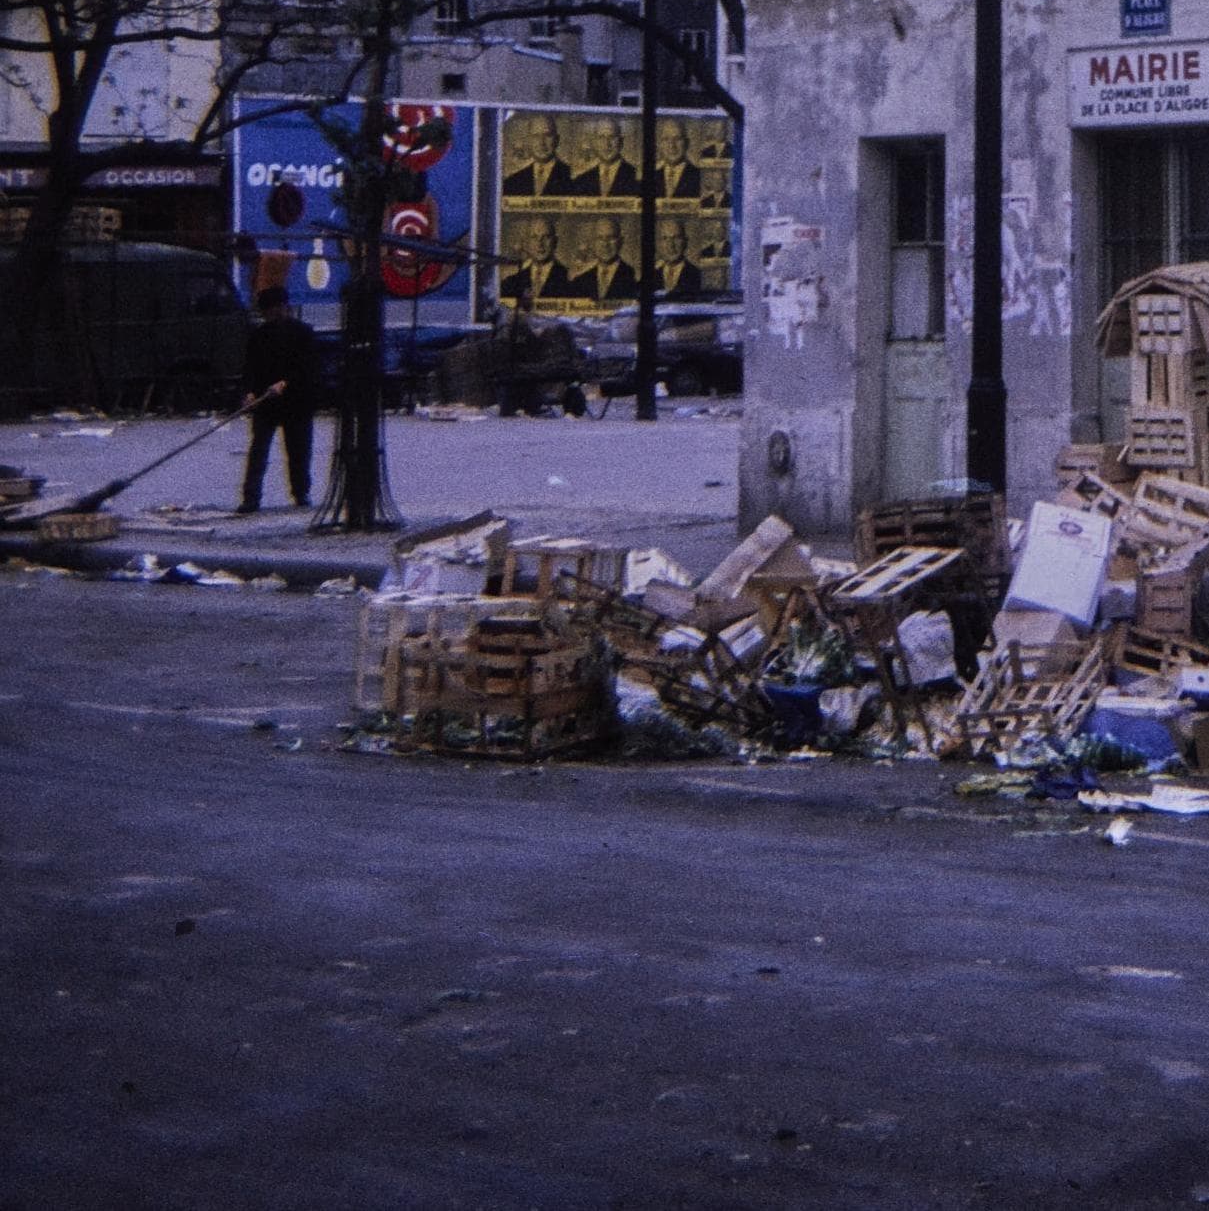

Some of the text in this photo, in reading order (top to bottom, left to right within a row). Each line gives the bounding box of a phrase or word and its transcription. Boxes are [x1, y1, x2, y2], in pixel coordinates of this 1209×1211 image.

[1088, 51, 1201, 86] MAIRIE
[1081, 98, 1209, 117] DE LA PLACE D'ALIGRE
